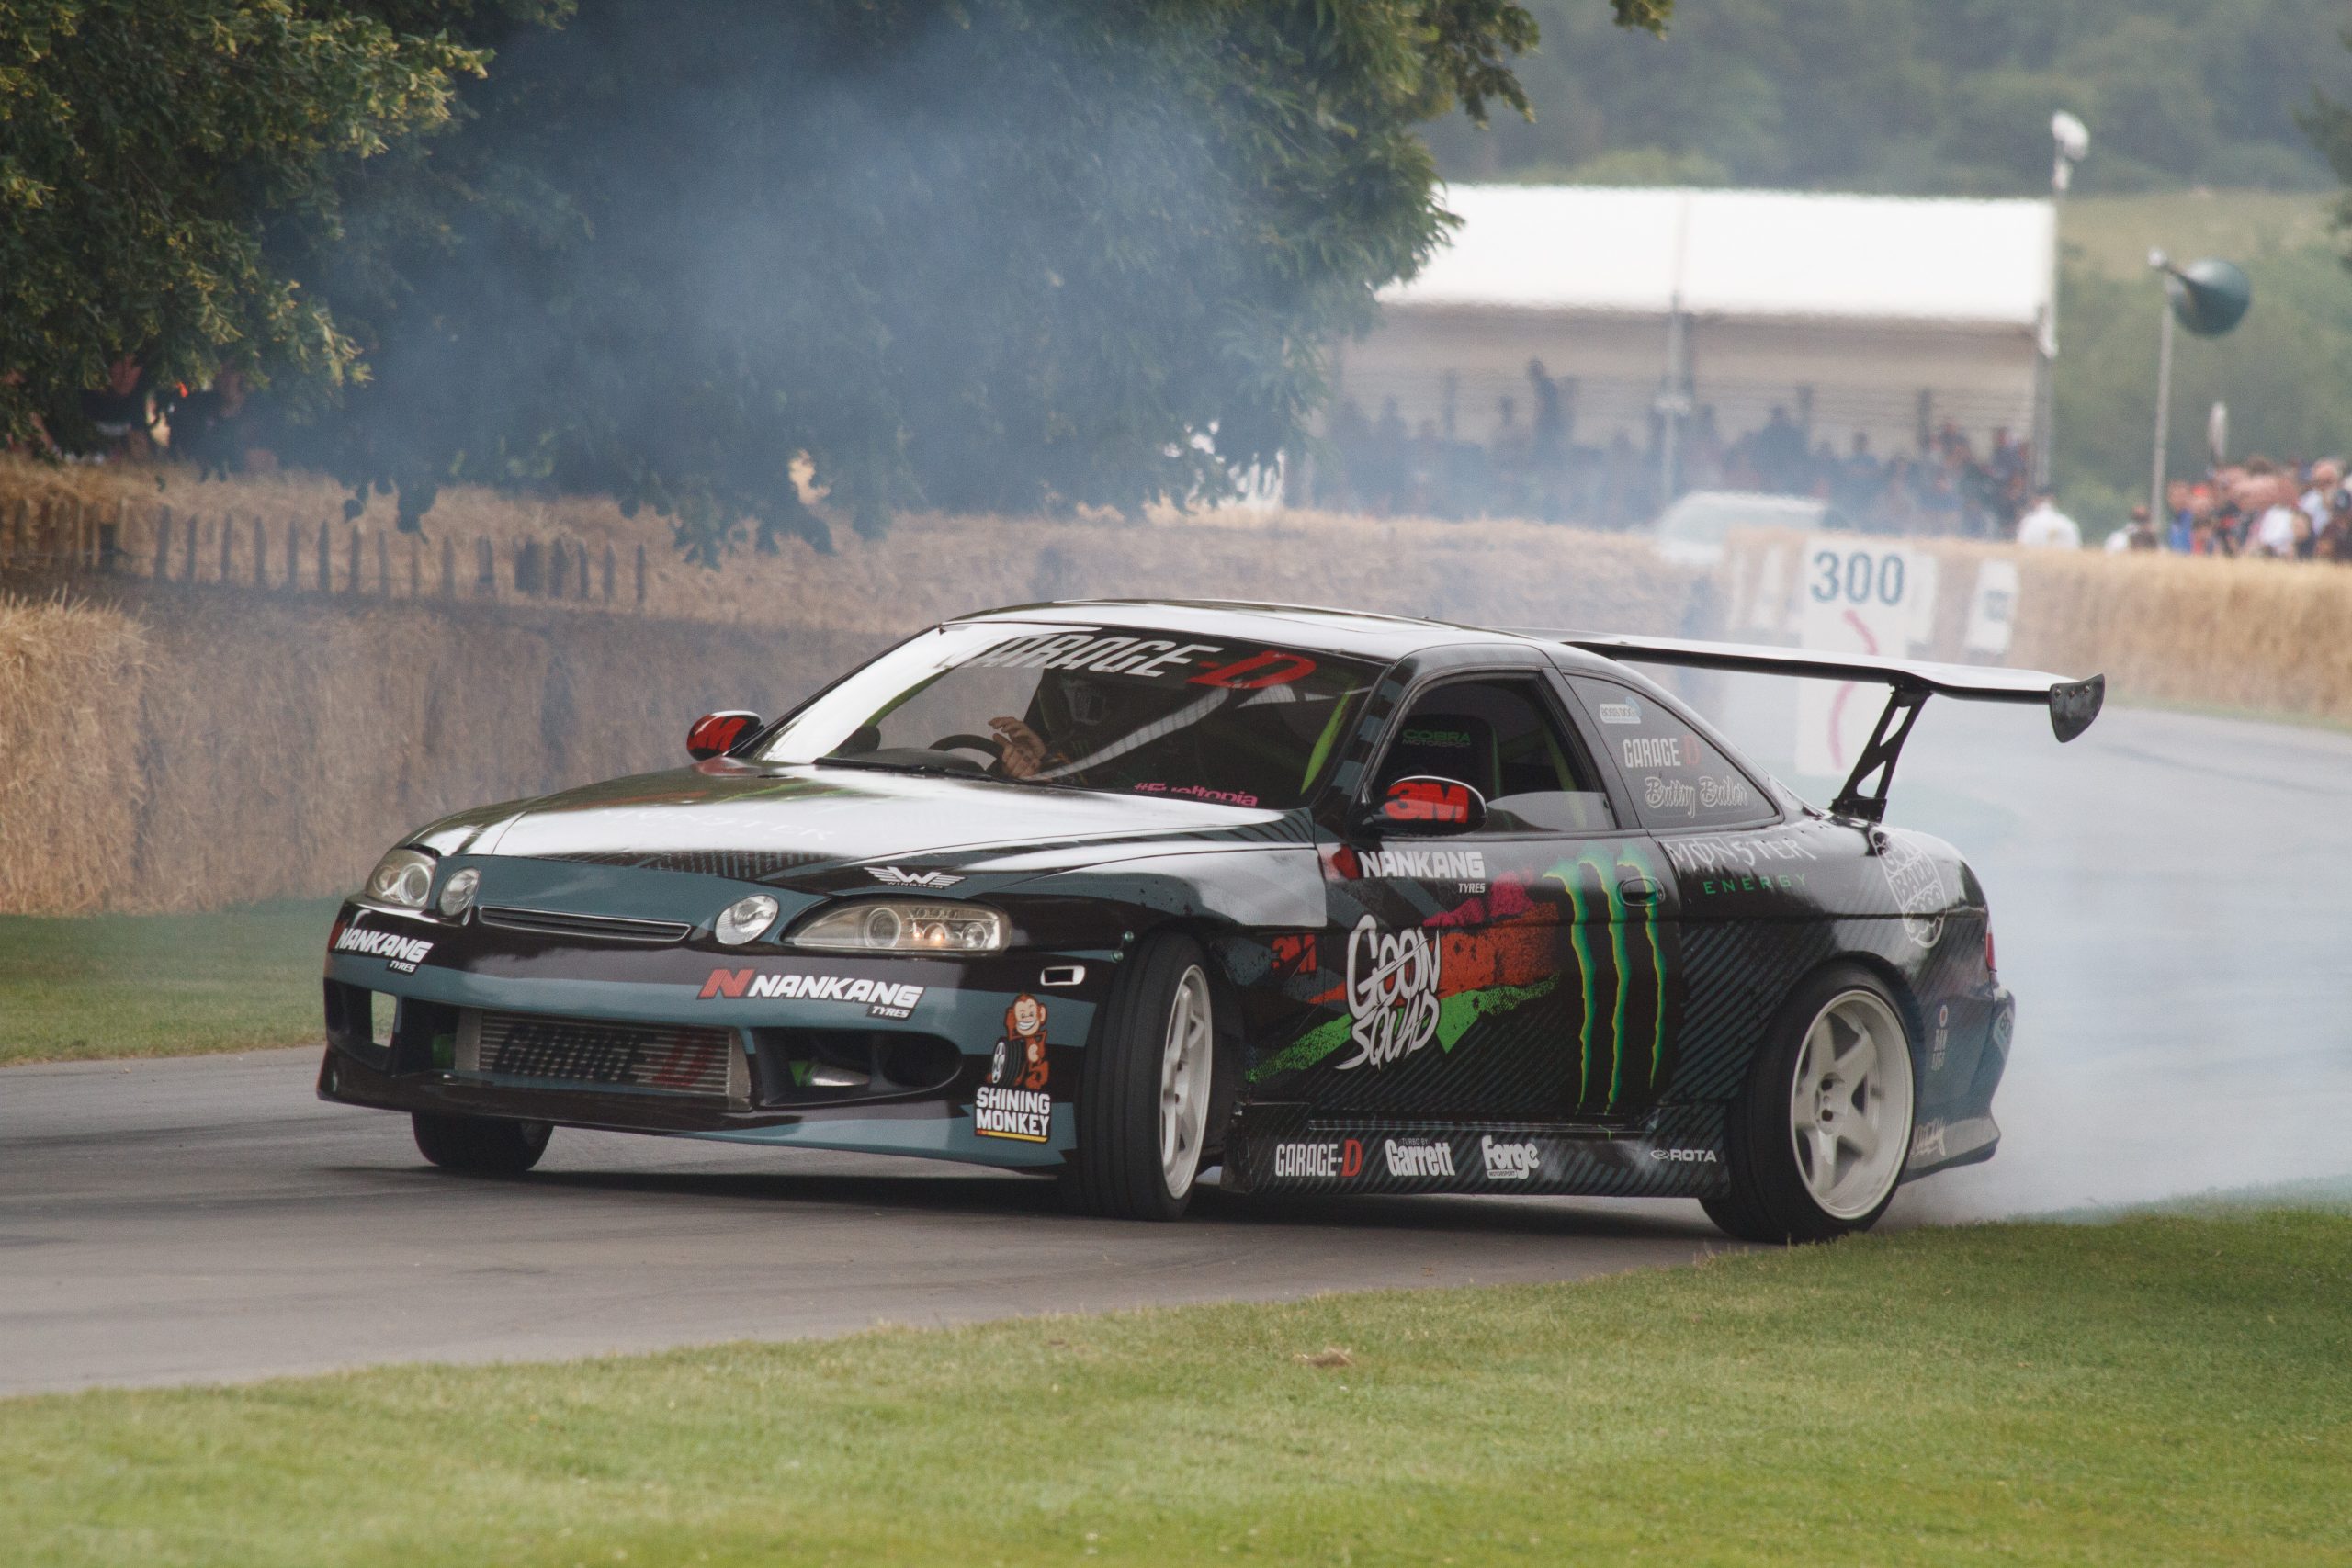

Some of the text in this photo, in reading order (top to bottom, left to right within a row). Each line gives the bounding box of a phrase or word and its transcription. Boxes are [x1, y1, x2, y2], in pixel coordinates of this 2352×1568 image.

[1808, 550, 1905, 606] 300
[946, 633, 1317, 689] ARAGE-D
[1402, 729, 1471, 743] COBRA
[1385, 782, 1469, 824] 3M
[1358, 851, 1486, 879] NANKANG
[1659, 834, 1818, 879] MONSTER
[1458, 883, 1486, 894] TYRES
[1702, 874, 1807, 895] ENERGY
[335, 928, 434, 963] NANKANG
[390, 960, 416, 973] TYRES
[1347, 914, 1441, 1020] GOON
[747, 975, 924, 1009] NANKANG
[872, 1005, 912, 1018] TYRES
[1334, 988, 1441, 1071] SQUAD
[976, 1086, 1051, 1115] SHINING
[976, 1108, 1050, 1136] MONKEY
[1274, 1139, 1363, 1177] GARAGE-D
[1385, 1139, 1455, 1177] Garrett
[1481, 1135, 1540, 1179] Forge
[1669, 1148, 1717, 1163] ROTA
